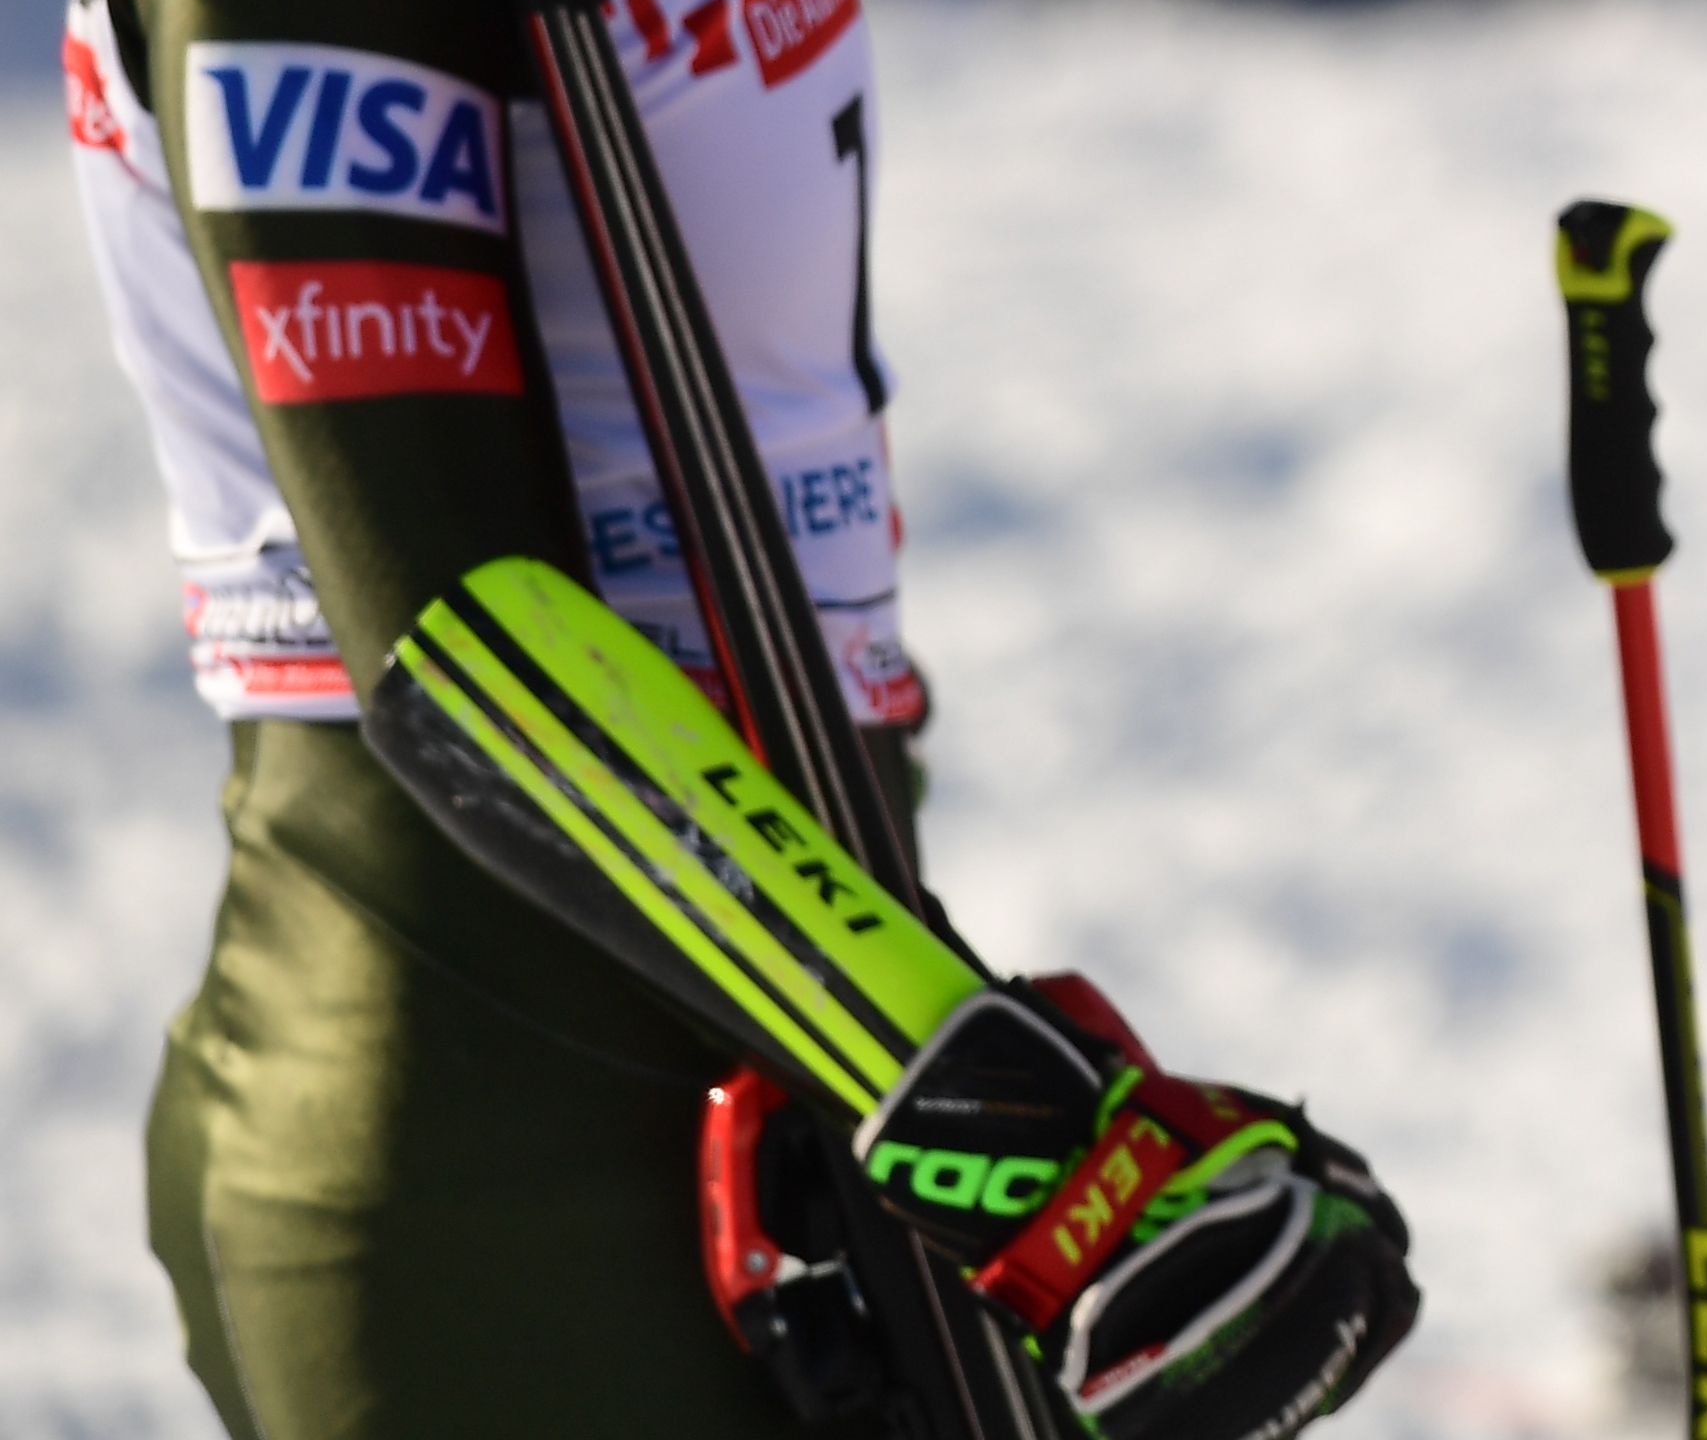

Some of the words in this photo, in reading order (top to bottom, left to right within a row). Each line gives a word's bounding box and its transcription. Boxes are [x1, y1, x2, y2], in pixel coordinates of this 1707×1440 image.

[203, 64, 497, 217] VISA
[256, 280, 492, 384] xfinity
[700, 763, 885, 938] LEKI
[1052, 1114, 1171, 1266] LEKI
